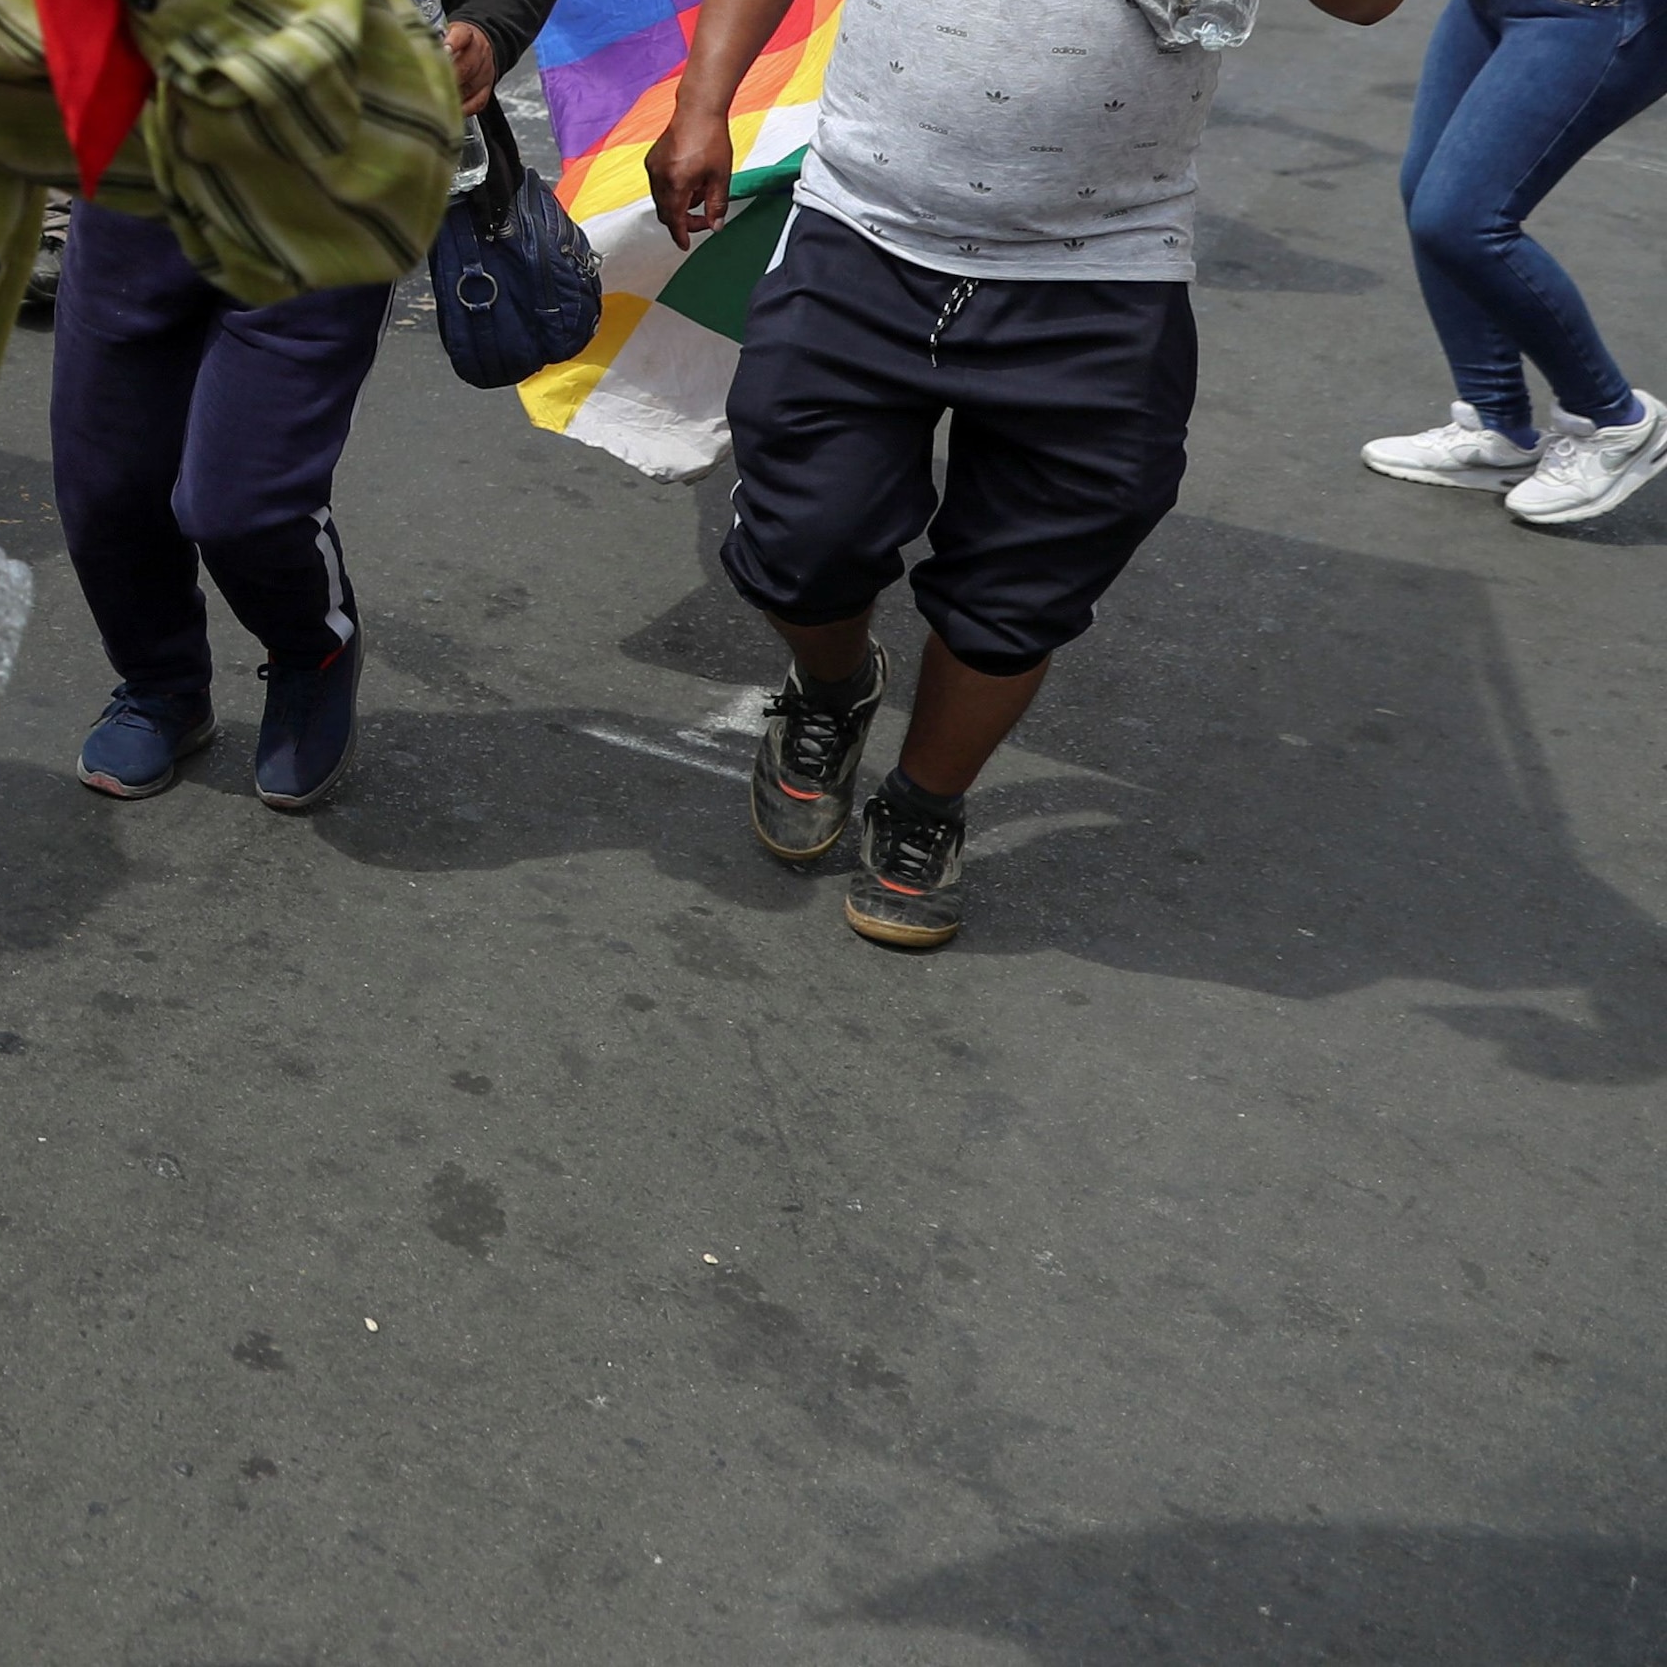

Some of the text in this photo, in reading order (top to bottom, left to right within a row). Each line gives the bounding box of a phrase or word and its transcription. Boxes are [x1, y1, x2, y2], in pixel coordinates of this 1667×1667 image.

[936, 24, 967, 37] adidas
[1052, 46, 1087, 56] adidas
[919, 122, 948, 135] adidas
[1030, 145, 1063, 154] adidas
